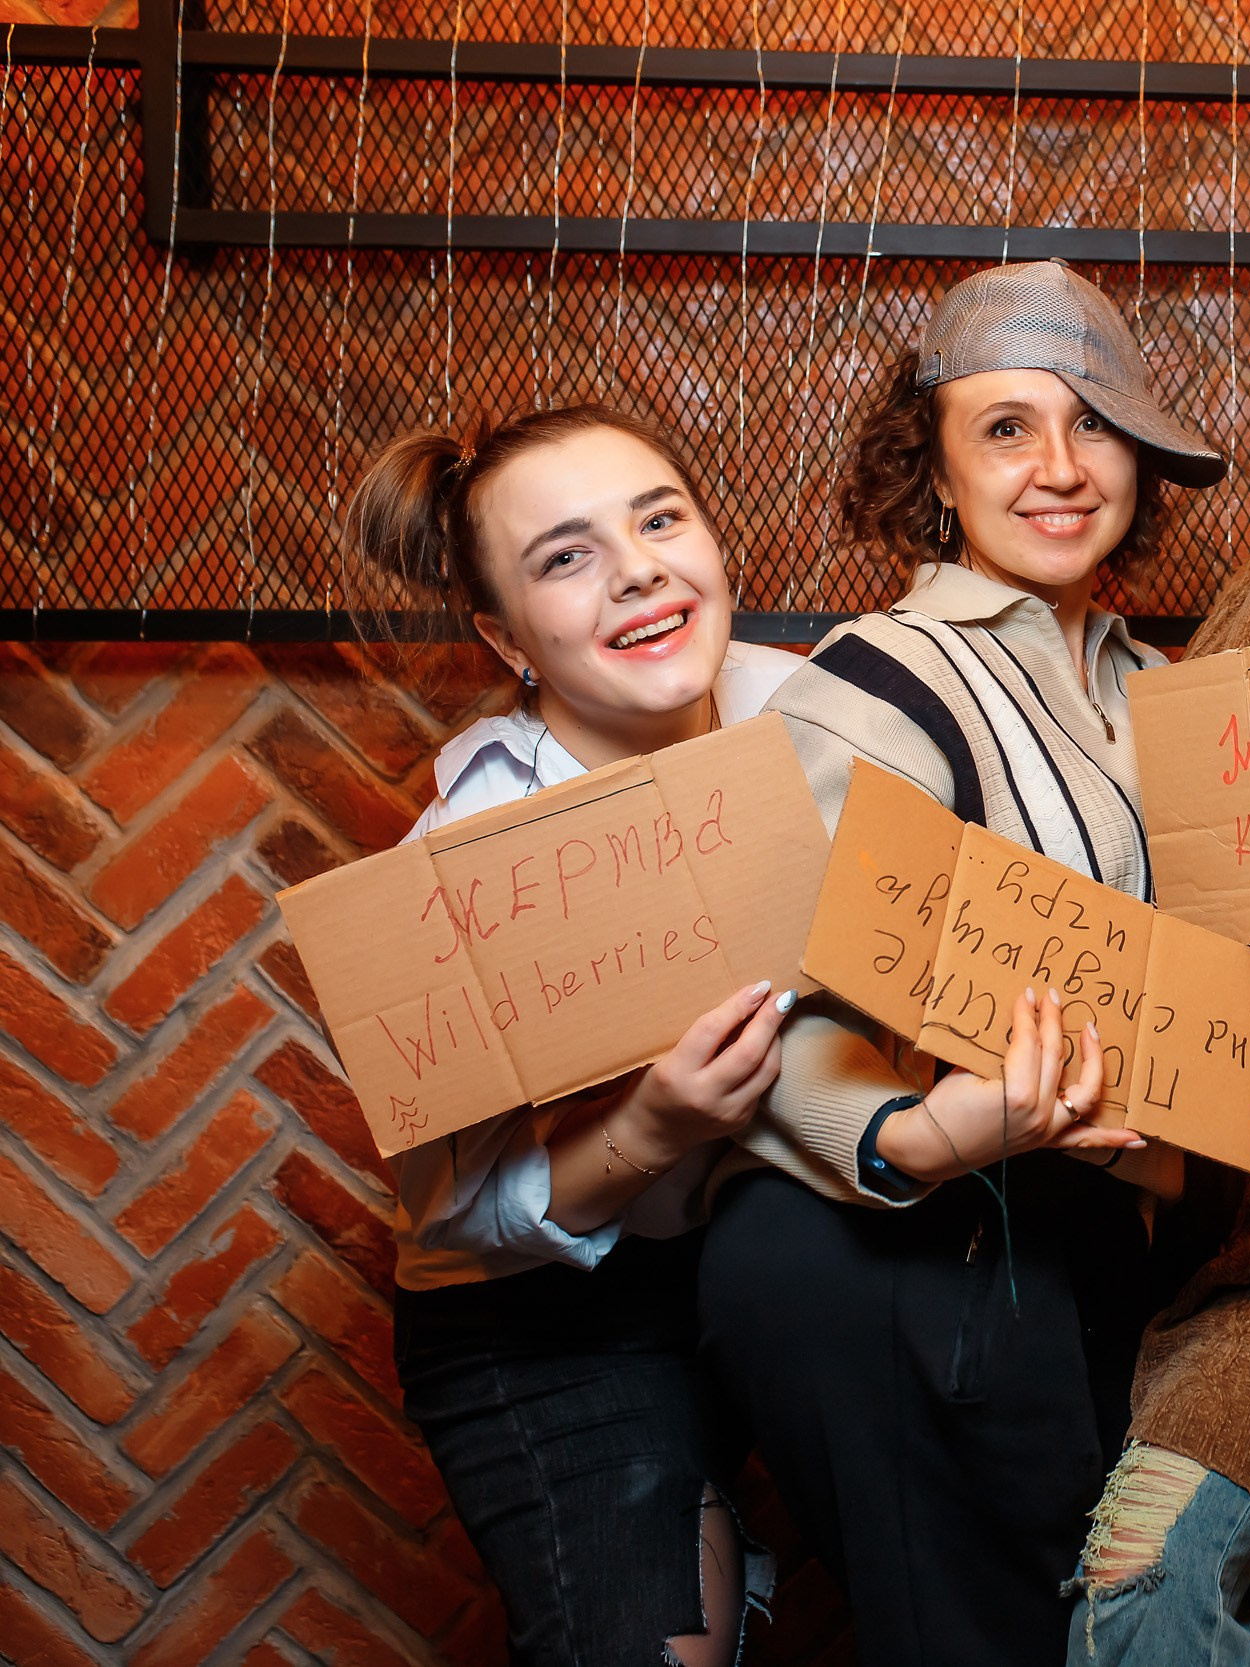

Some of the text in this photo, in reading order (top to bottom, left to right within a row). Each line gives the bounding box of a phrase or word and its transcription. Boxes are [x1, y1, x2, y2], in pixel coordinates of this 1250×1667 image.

[872, 928, 1179, 1111] Подйте
[874, 873, 1248, 1069] на следующую
